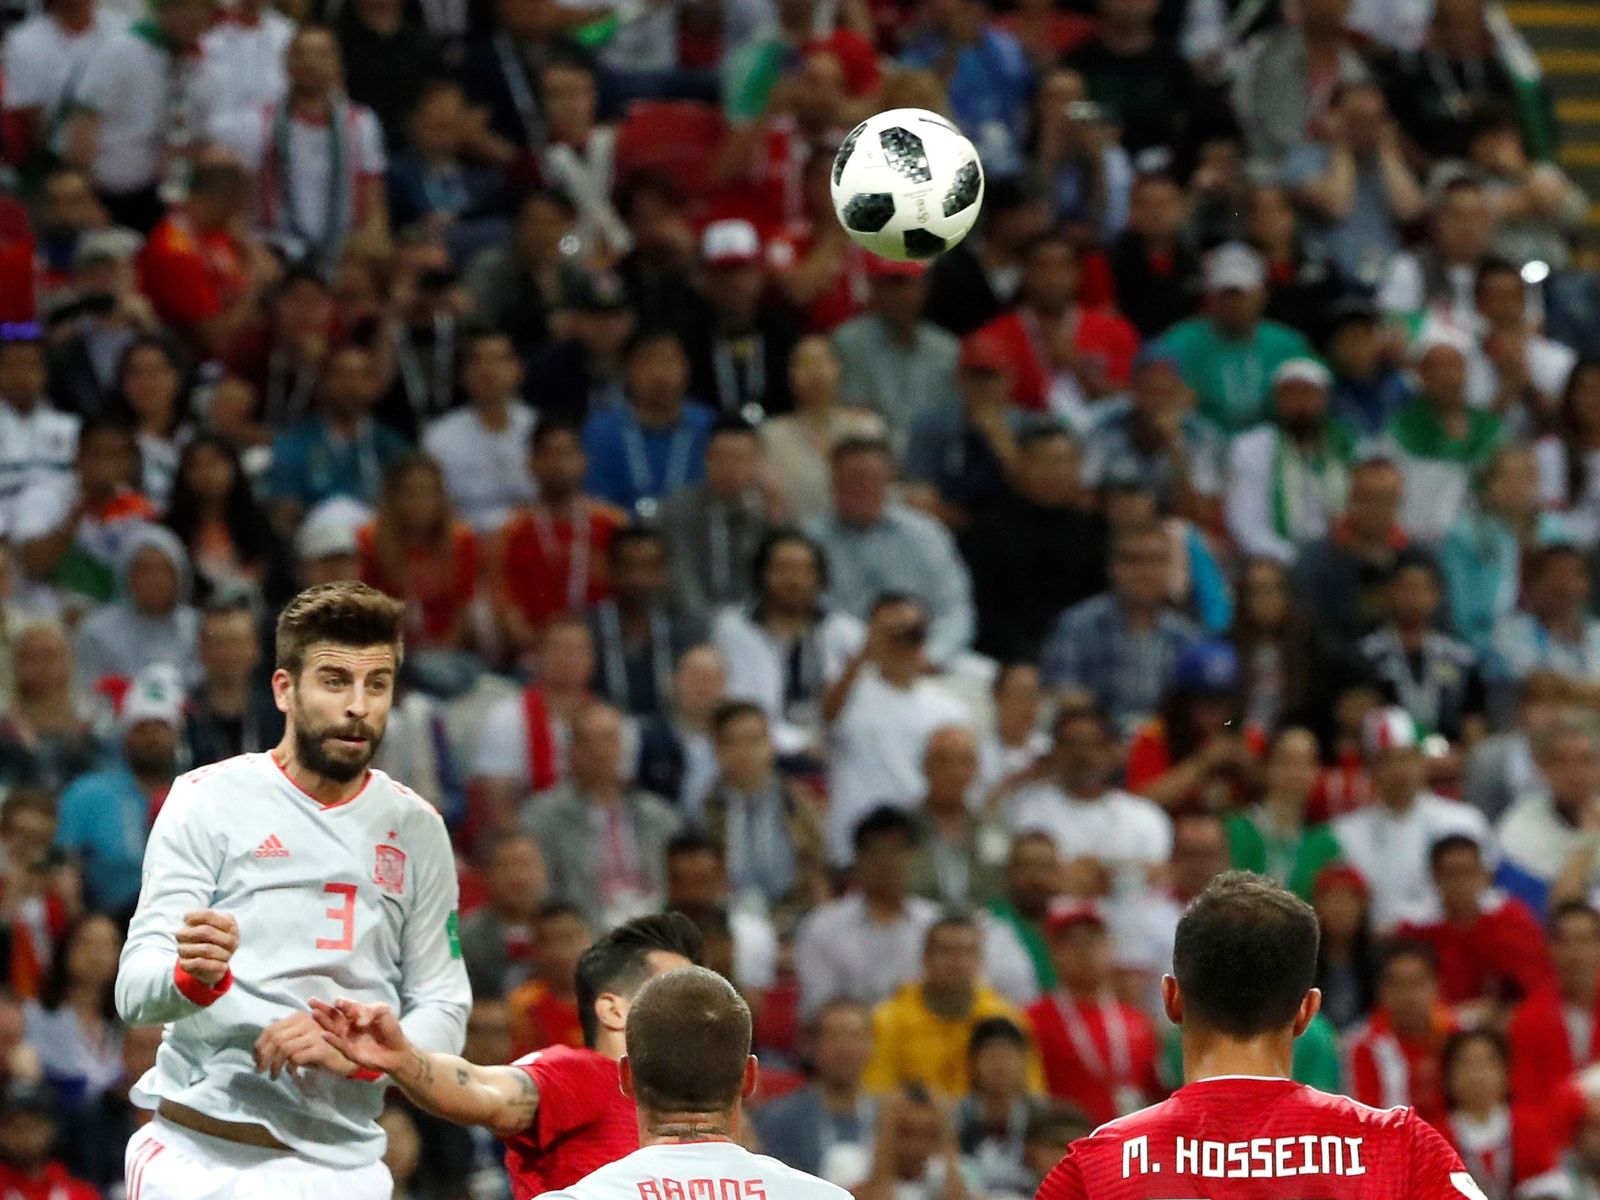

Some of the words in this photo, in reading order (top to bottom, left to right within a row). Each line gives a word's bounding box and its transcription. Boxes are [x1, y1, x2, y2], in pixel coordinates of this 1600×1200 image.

[316, 882, 358, 951] 3
[1122, 1135, 1161, 1179] M.
[1176, 1135, 1366, 1178] HOSSEINI
